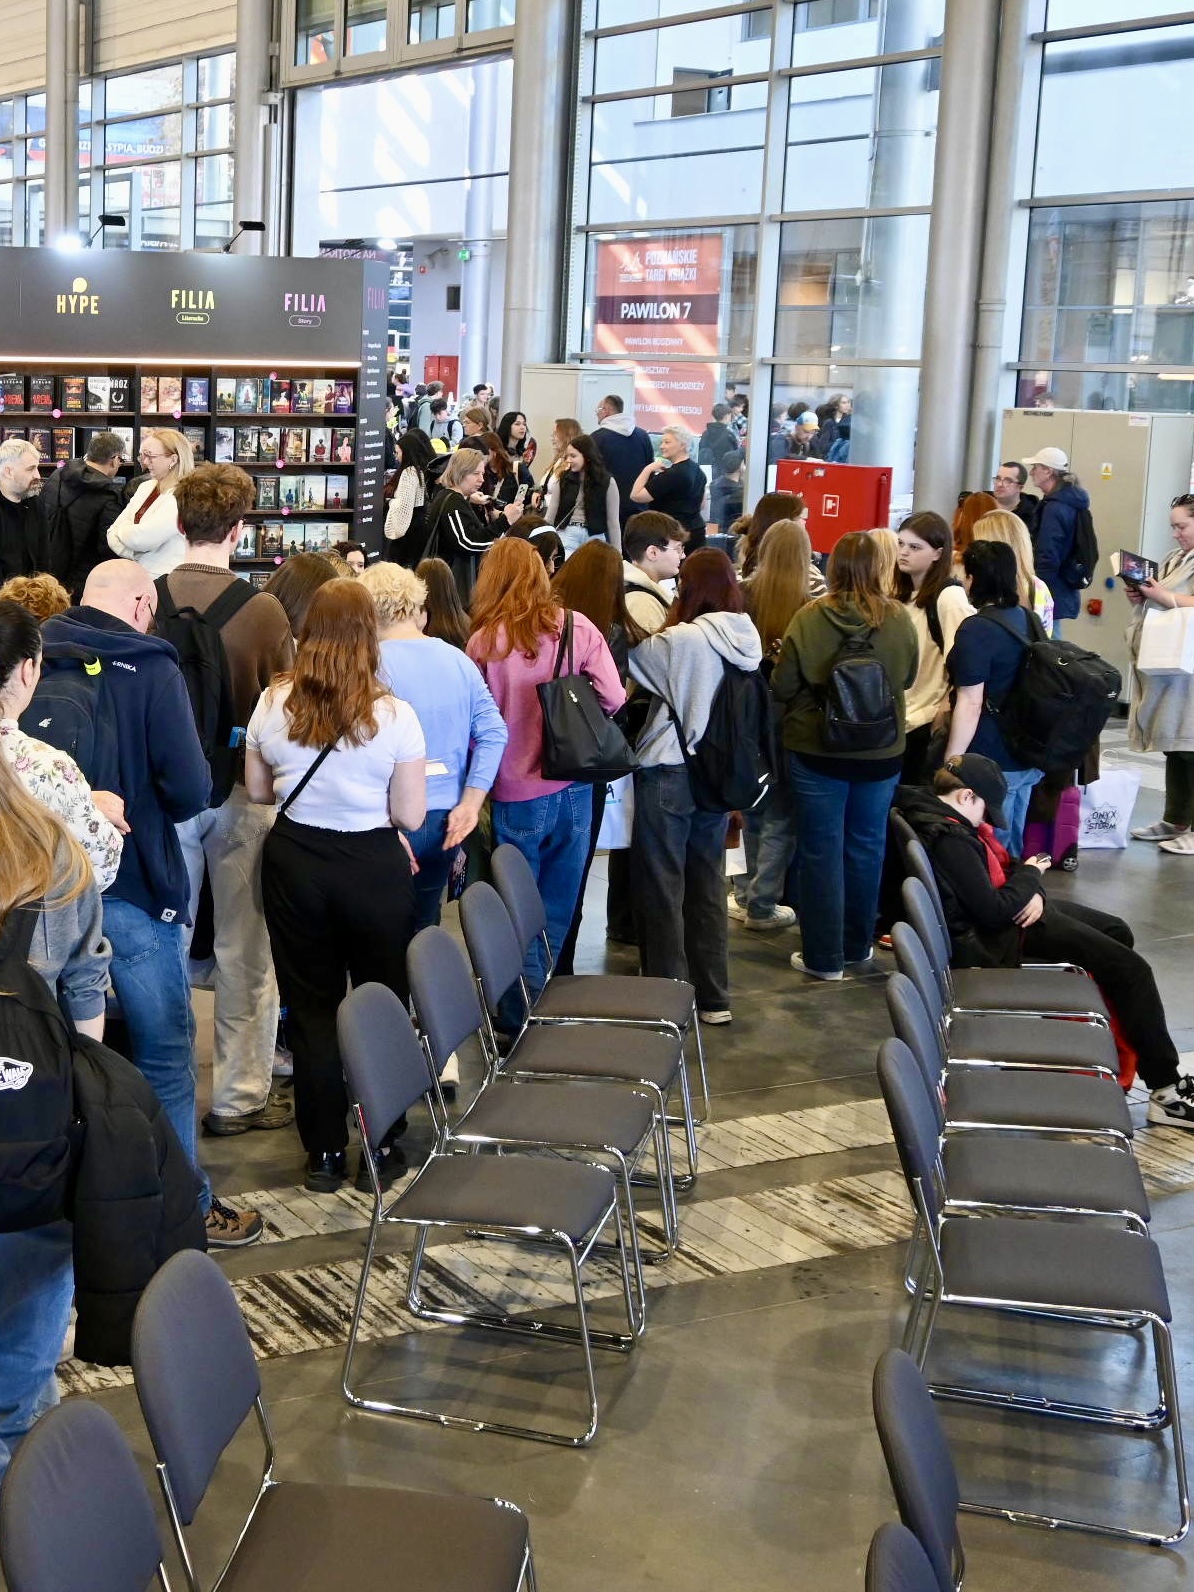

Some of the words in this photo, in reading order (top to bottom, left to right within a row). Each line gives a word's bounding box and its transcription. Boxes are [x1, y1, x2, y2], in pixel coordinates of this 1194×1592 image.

[646, 268, 666, 282] TARGI
[56, 294, 99, 315] HYPE
[171, 289, 215, 310] FILIA
[284, 293, 326, 313] FILIA
[367, 287, 385, 310] FILIA
[621, 302, 681, 320] PAWILON
[683, 301, 692, 319] 7
[1092, 810, 1117, 820] ONYX
[1088, 822, 1116, 830] STORM
